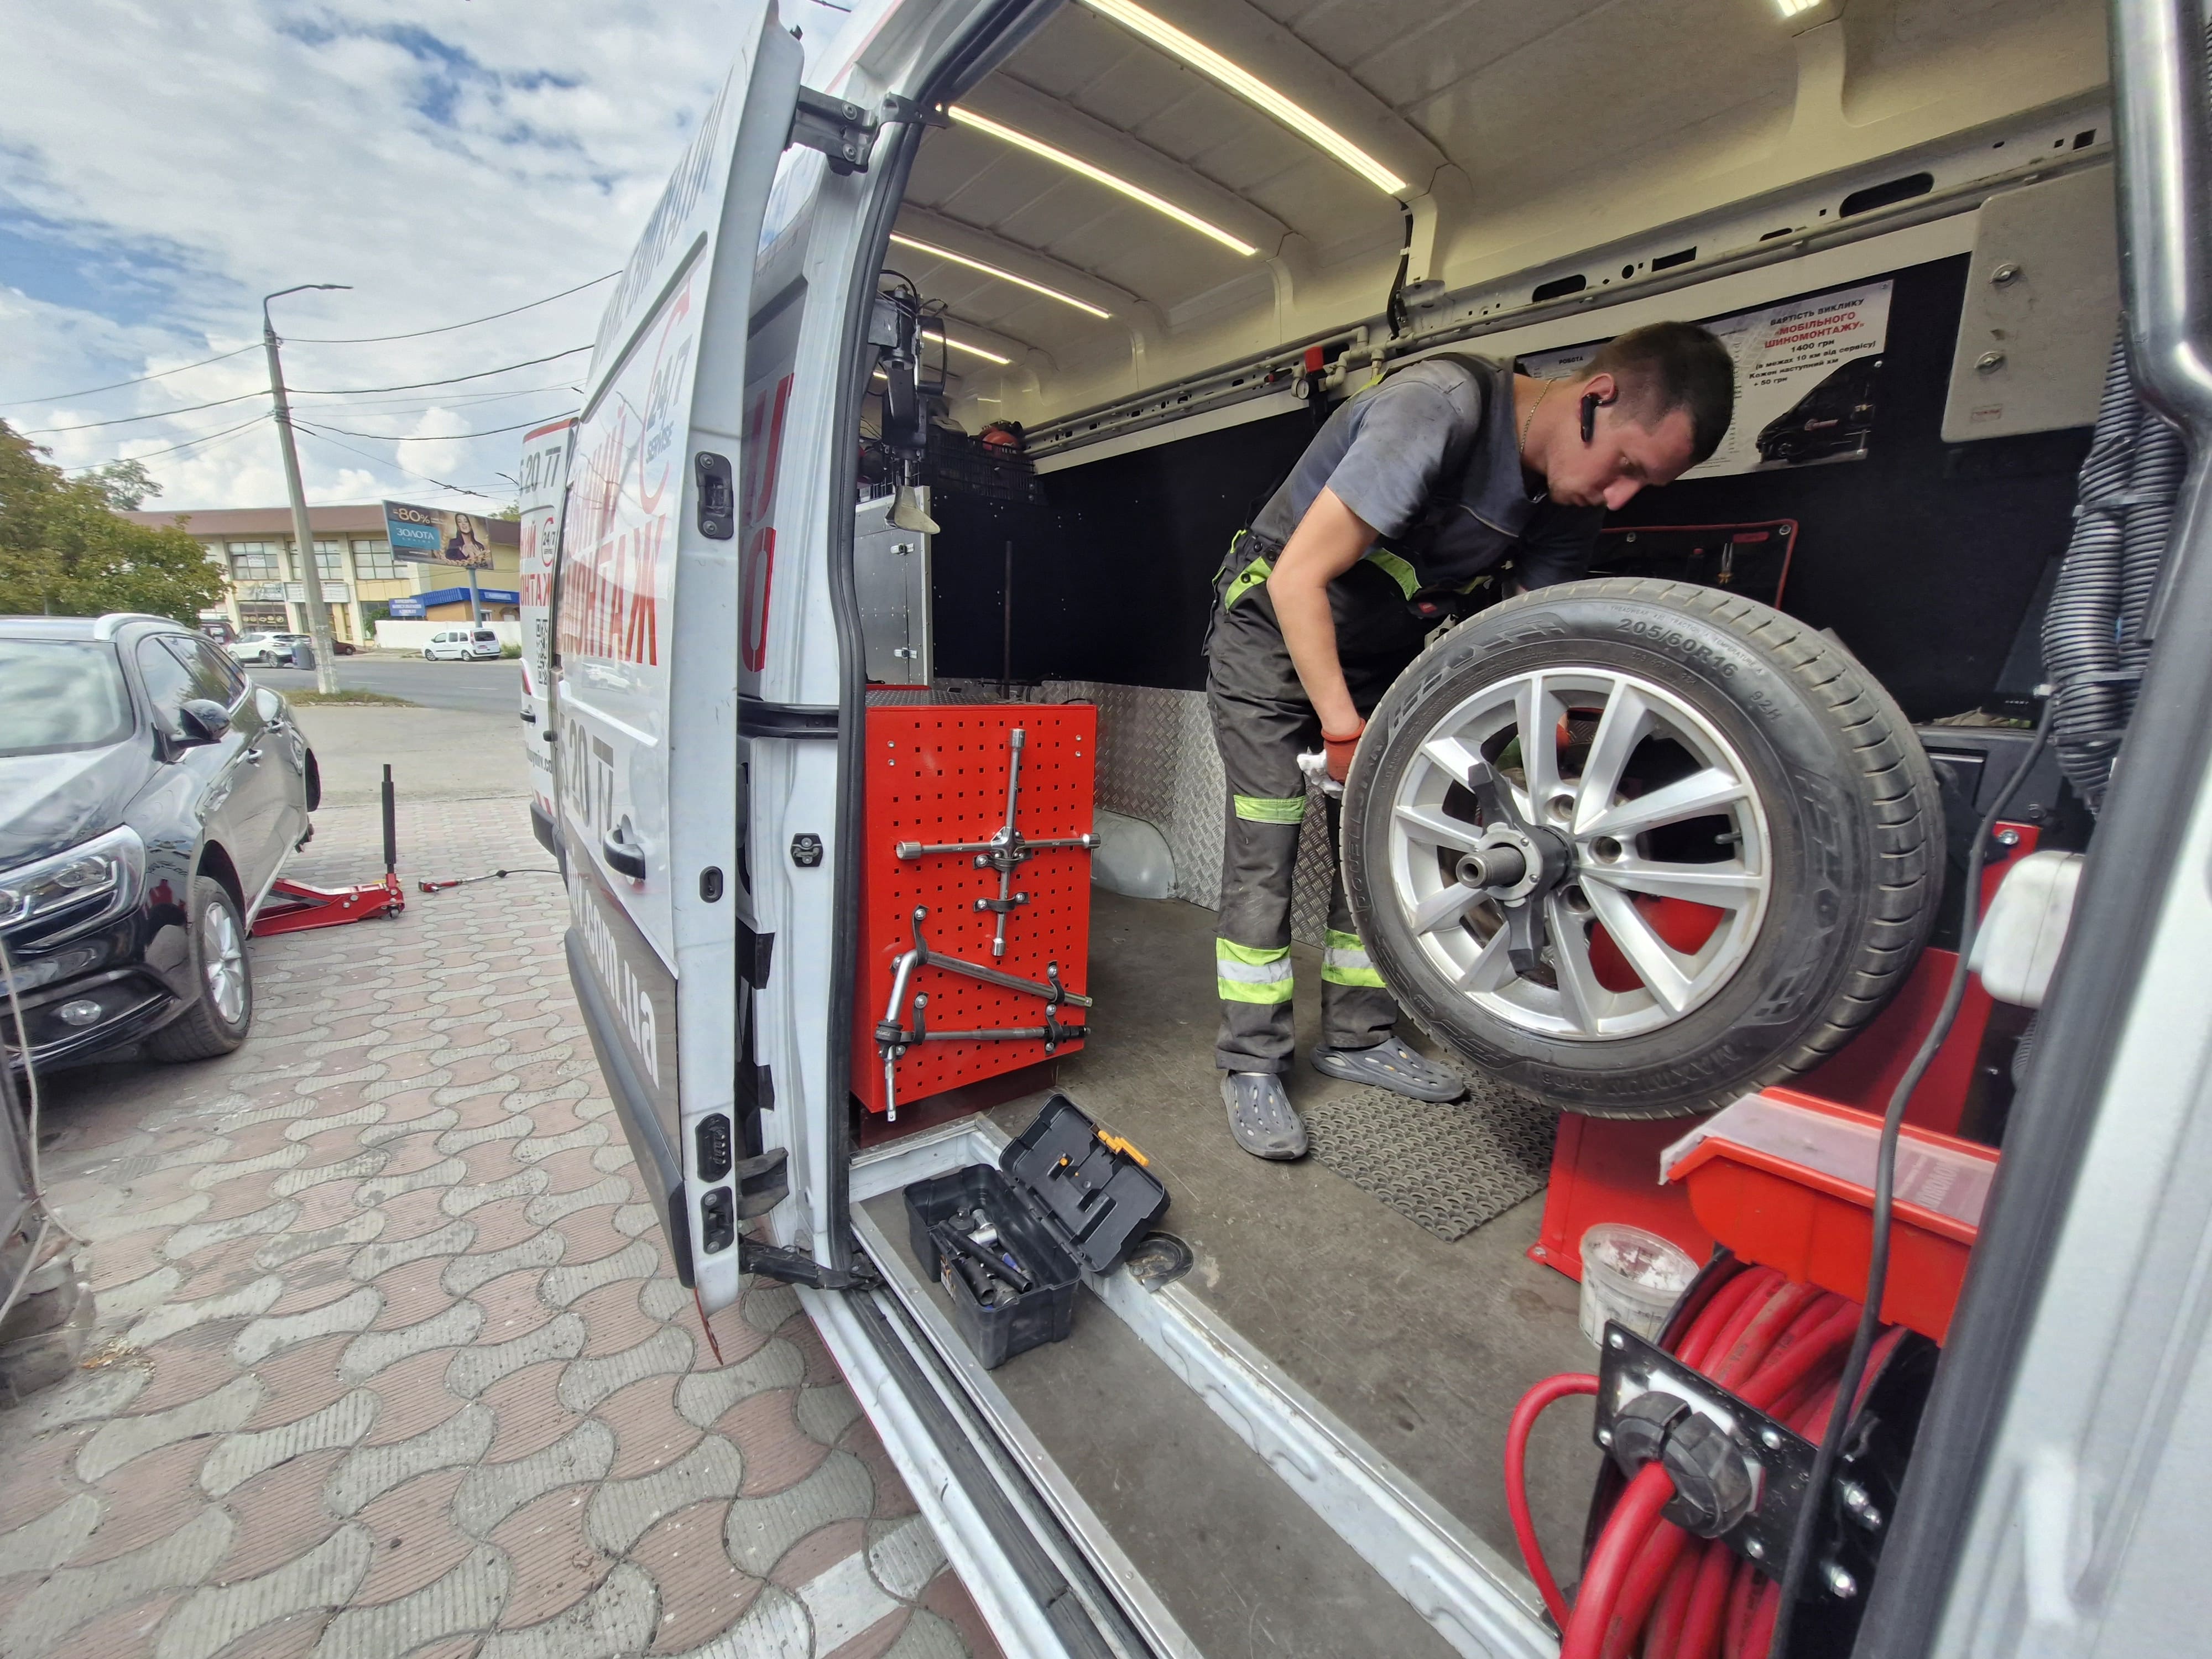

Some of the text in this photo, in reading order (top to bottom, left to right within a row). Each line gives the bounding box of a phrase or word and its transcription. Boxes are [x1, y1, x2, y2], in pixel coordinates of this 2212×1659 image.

[1818, 299, 1864, 315] ВИКЛИКУ
[1791, 343, 1814, 352] 1400
[1614, 618, 1740, 679] 205/60R16
[1747, 690, 1783, 720] 92H
